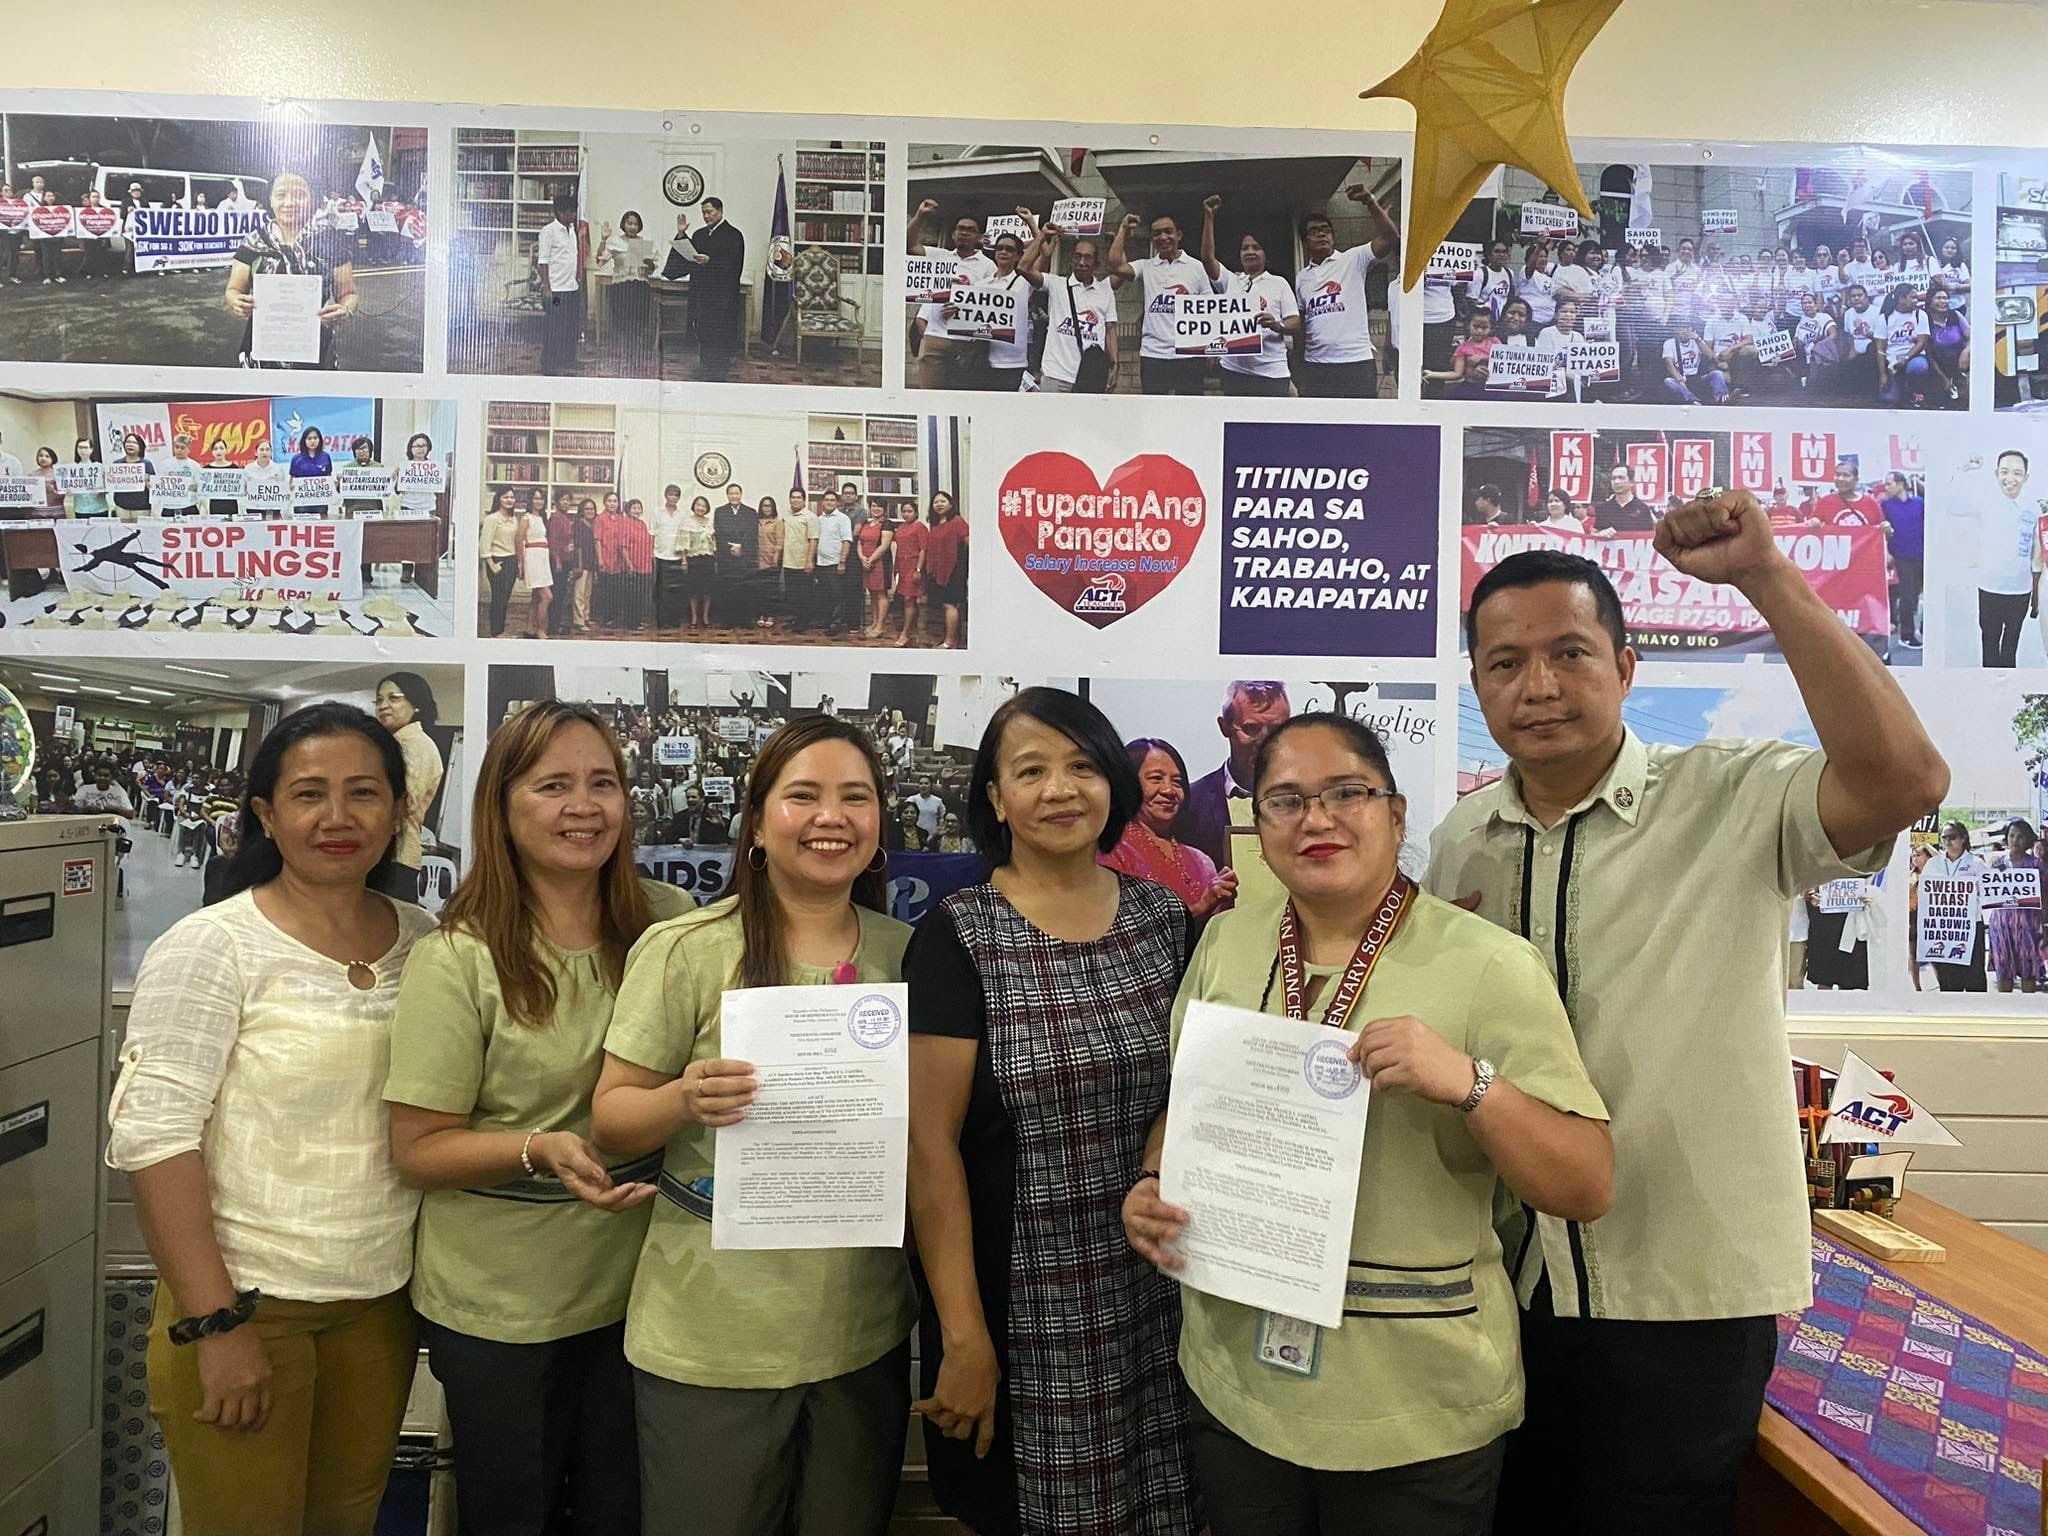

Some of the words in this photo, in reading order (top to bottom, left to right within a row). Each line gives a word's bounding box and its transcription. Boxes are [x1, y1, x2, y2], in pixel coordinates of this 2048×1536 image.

[135, 210, 219, 236] SWELDO
[1627, 230, 1658, 238] SAHOD
[954, 290, 1015, 309] SAHOD
[1150, 294, 1175, 309] AC
[1183, 298, 1251, 315] REPEAL
[953, 308, 1014, 327] ITAAS!
[1176, 320, 1212, 335] CPD
[1220, 318, 1258, 335] LAW
[1755, 334, 1788, 348] SAHOD
[1491, 350, 1504, 360] ANG
[1527, 352, 1535, 362] NA
[1569, 346, 1616, 357] SAHOD
[1760, 343, 1791, 358] ITAAS!
[1492, 362, 1504, 374] NG
[1507, 363, 1549, 377] TEACHERS!
[1570, 359, 1616, 370] ITAAS!
[200, 418, 267, 455] KMP
[1559, 436, 1583, 496] KMU
[1741, 433, 1766, 488] KMU
[88, 467, 98, 478] 32
[108, 465, 143, 474] JUSTICE
[405, 469, 440, 477] KILLING
[1633, 448, 1658, 500] KMU
[1680, 444, 1703, 497] KMU
[303, 478, 327, 486] STOP
[1232, 466, 1370, 491] TITINDIG
[258, 485, 280, 494] END
[298, 484, 330, 492] KILLING
[1001, 488, 1203, 528] #TuparinAng
[1231, 497, 1316, 519] PARA
[1323, 498, 1365, 520] SA
[161, 526, 246, 548] STOP
[266, 525, 336, 549] THE
[1037, 521, 1172, 557] Pangako
[1230, 527, 1350, 554] SAHOD,
[161, 550, 342, 579] KILLINGS!
[1024, 555, 1072, 574] Salary
[1074, 555, 1137, 571] Increase
[1139, 556, 1178, 572] Now!
[1232, 556, 1391, 584] TRABAHO,
[1400, 564, 1431, 581] AT
[1077, 588, 1122, 605] ACT
[1230, 586, 1429, 611] KARAPATAN!
[1638, 634, 1680, 646] MAYO
[1687, 635, 1720, 647] UNO
[1829, 880, 1859, 889] PEACE
[1982, 872, 2036, 883] SAHOD
[1924, 879, 1974, 893] SWELDO
[1983, 886, 2036, 897] ITAAS!
[1929, 893, 1969, 906] ITAAS!
[1928, 906, 1968, 918] DAGDAG
[1361, 889, 1404, 955] SCHOOL
[1923, 918, 1937, 929] NA
[1940, 918, 1971, 930] BUWIS
[1924, 929, 1969, 942] IBASURA!
[1833, 1101, 1908, 1132] ACT
